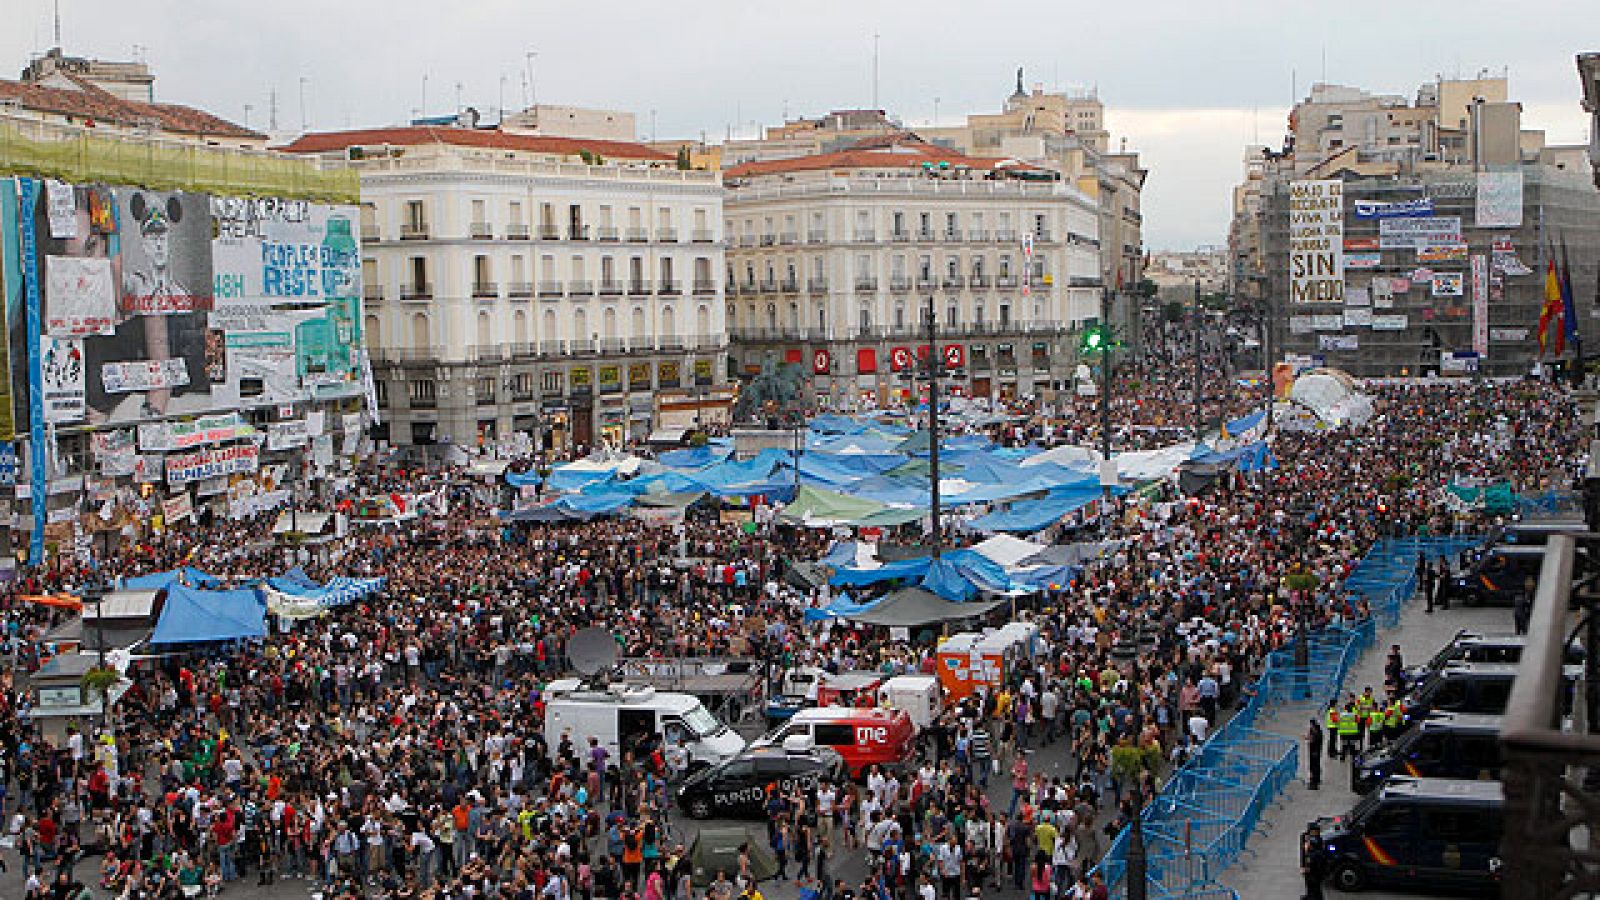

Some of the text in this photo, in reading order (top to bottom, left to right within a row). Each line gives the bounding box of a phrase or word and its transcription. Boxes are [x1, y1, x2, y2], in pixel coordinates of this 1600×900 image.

[1292, 252, 1334, 278] SIN
[264, 266, 319, 296] RISE
[714, 786, 764, 806] PUNTO
